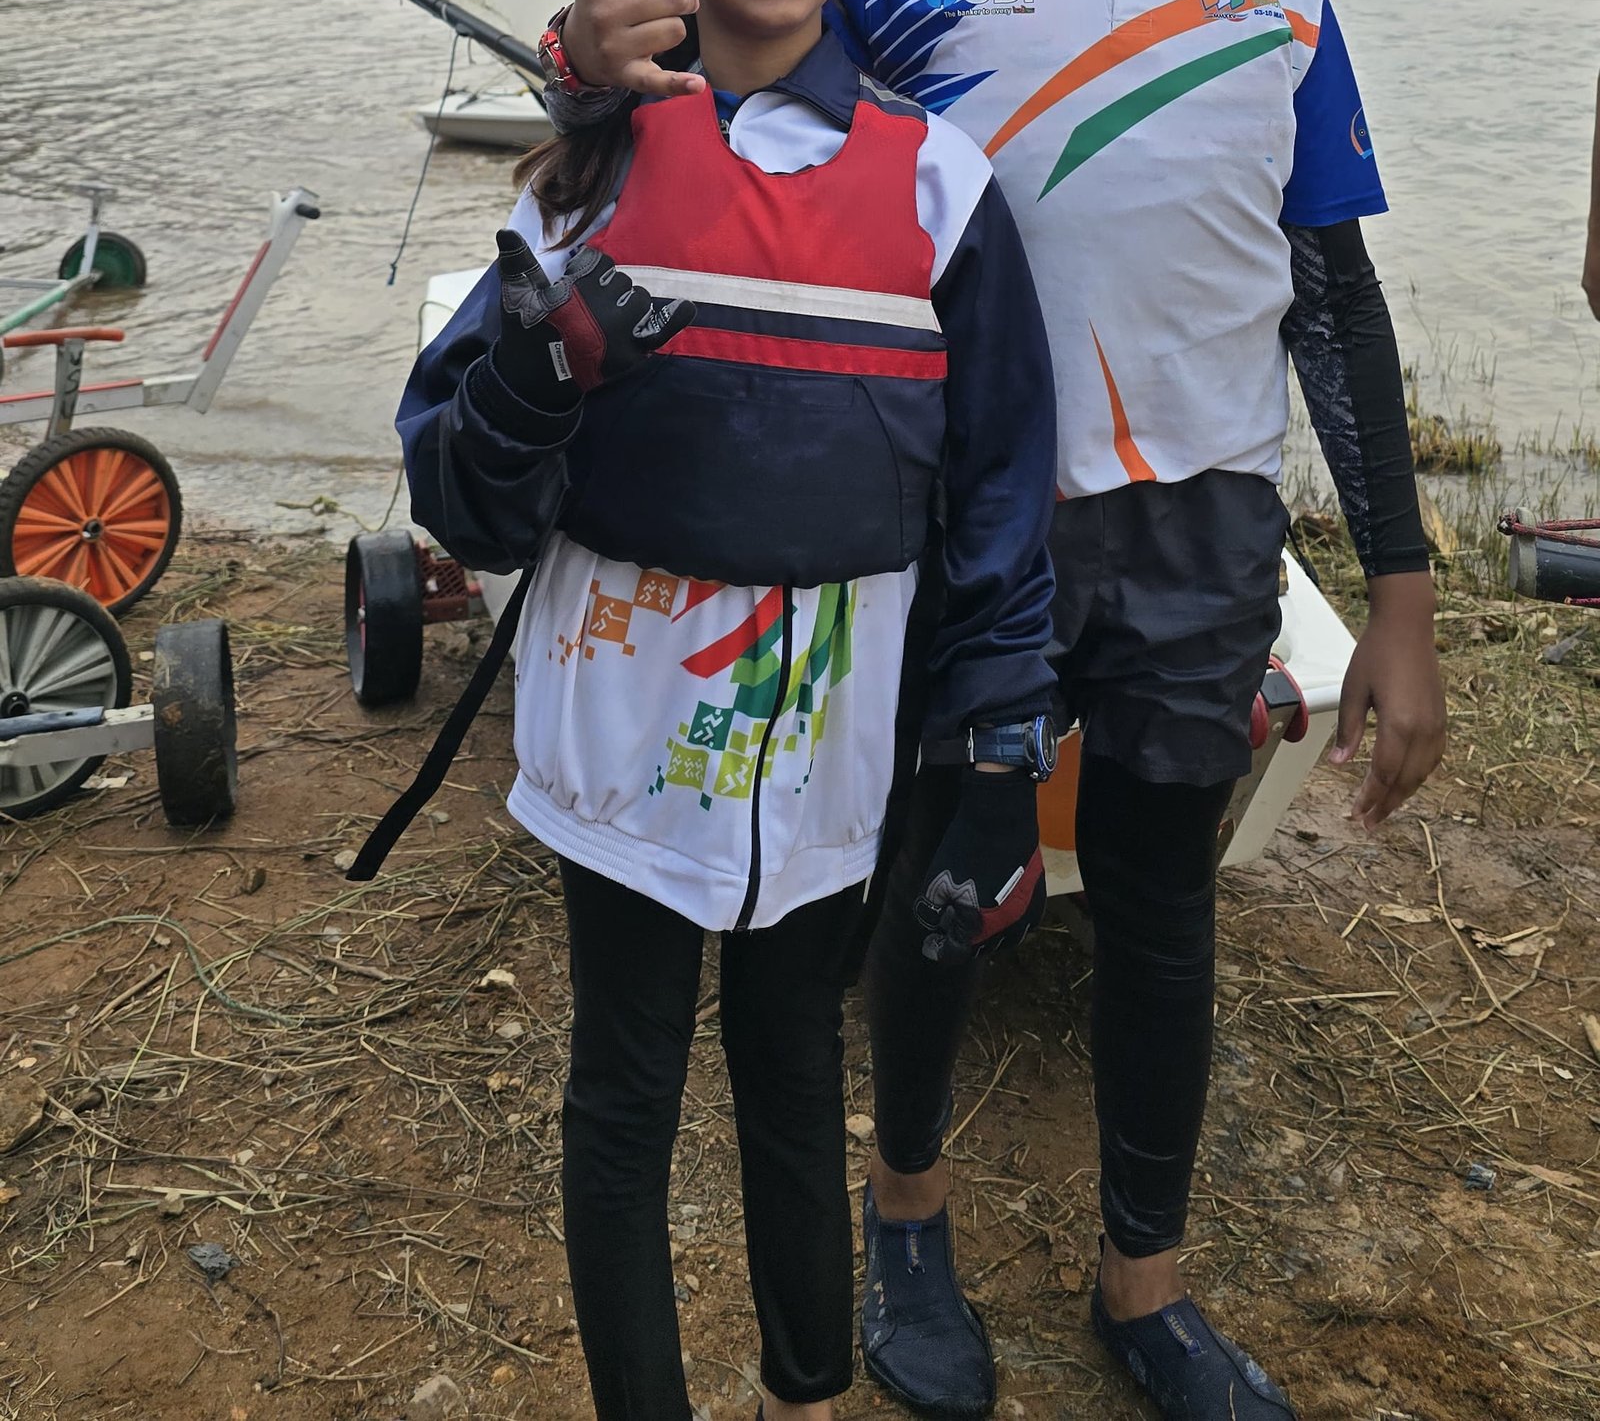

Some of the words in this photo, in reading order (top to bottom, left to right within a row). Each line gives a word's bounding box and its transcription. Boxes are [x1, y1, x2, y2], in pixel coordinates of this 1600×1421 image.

[957, 8, 980, 17] banker
[982, 7, 991, 15] to
[991, 7, 1012, 16] every
